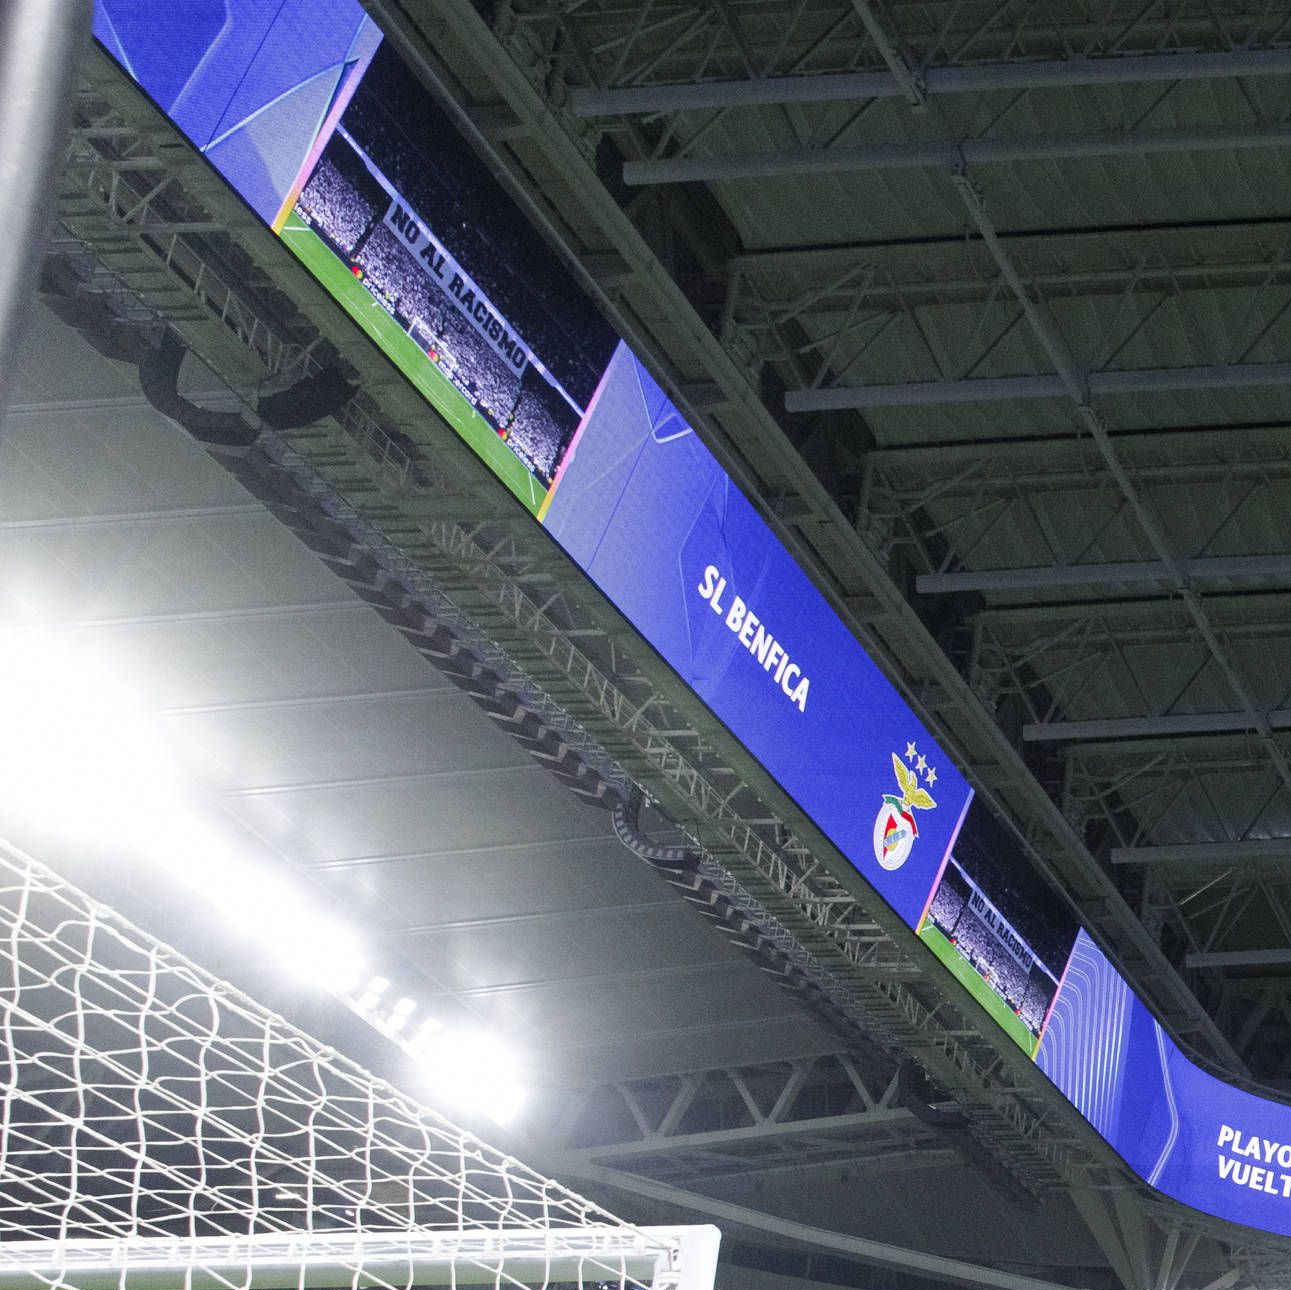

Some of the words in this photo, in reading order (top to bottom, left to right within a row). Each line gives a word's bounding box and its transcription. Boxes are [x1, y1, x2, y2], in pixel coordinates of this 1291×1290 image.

[391, 205, 420, 244] NO
[420, 245, 445, 279] AL
[447, 272, 527, 369] RACISMO
[697, 564, 727, 615] SL
[725, 595, 810, 713] BENFICA
